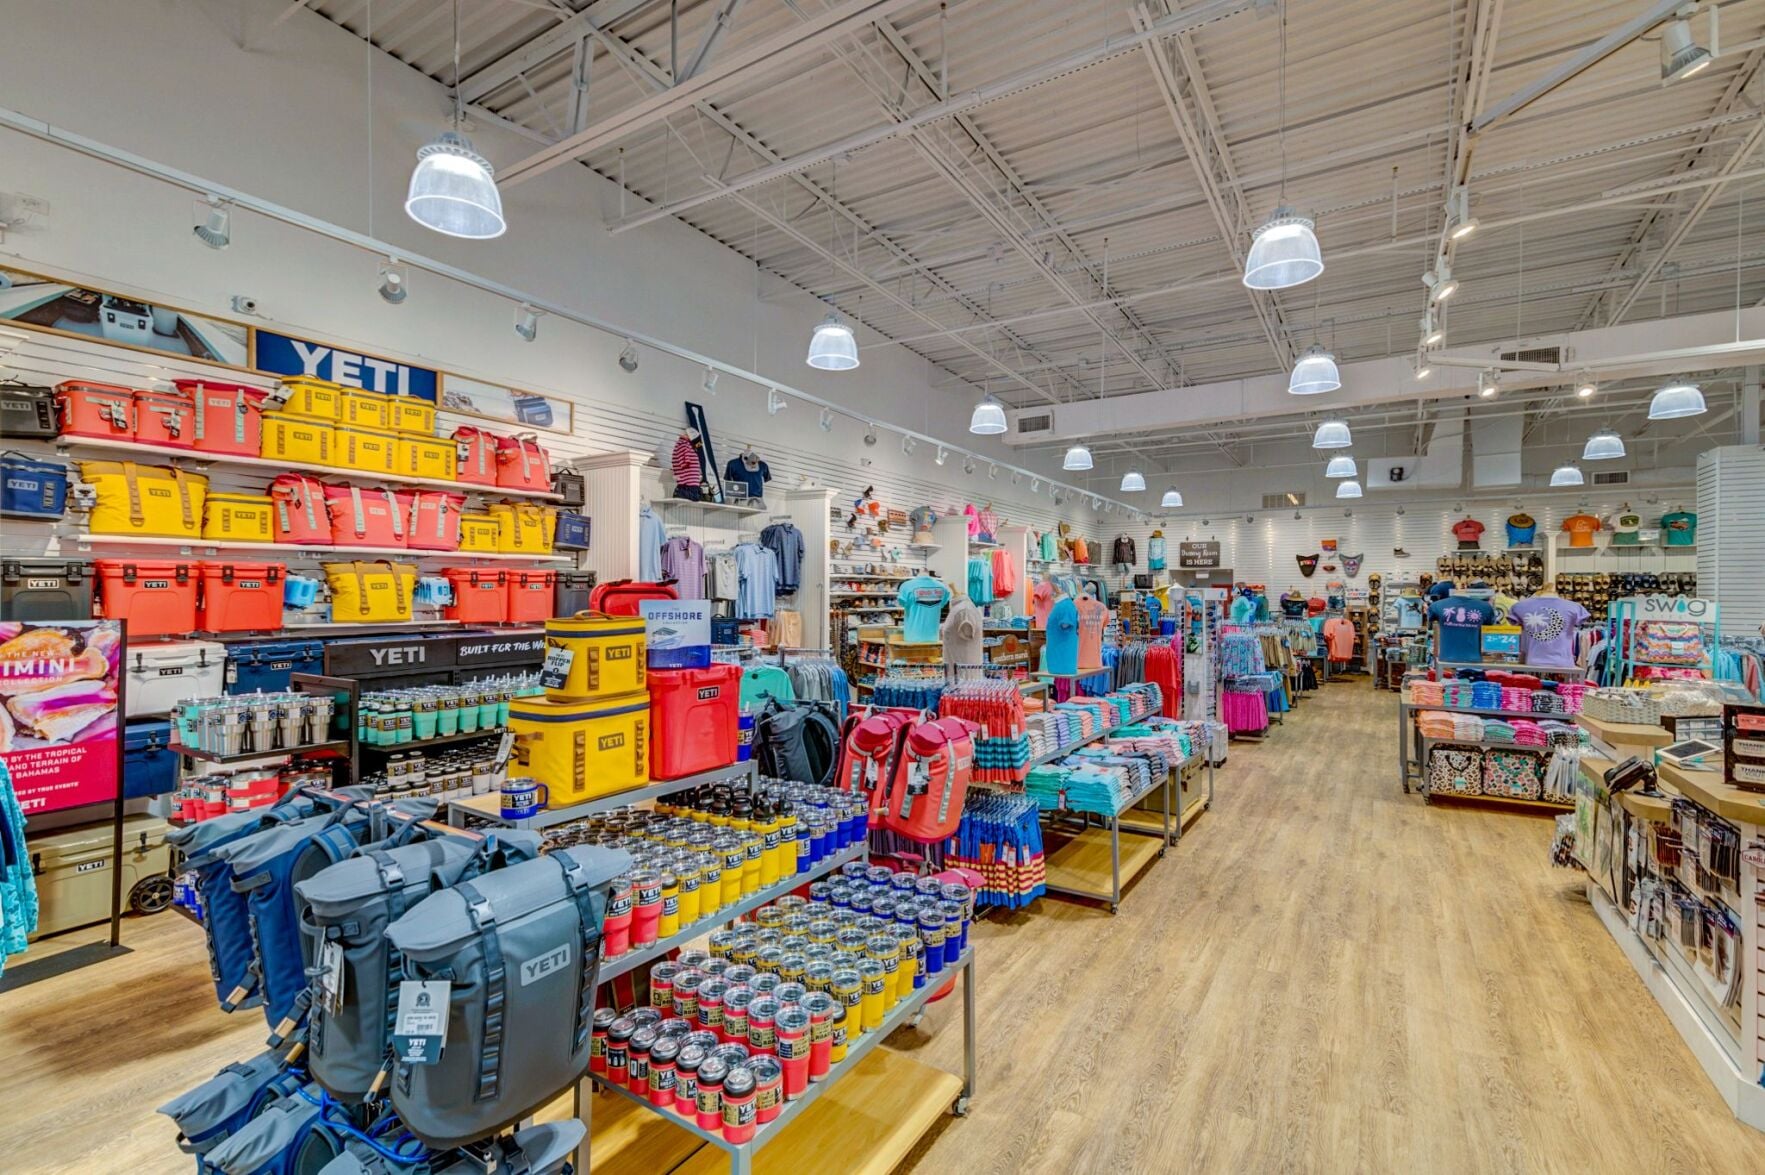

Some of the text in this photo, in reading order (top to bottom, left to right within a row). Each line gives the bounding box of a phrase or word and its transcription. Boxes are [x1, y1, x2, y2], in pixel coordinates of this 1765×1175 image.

[290, 340, 410, 396] YETI
[4, 402, 30, 410] YETI
[10, 480, 37, 489] YETI
[29, 580, 58, 588] YETI
[648, 611, 703, 620] OFFSHORE
[460, 640, 547, 656] BUILT FOR THE WI
[606, 646, 631, 659] YETI
[369, 646, 426, 666] YETI
[3, 658, 75, 677] IMINI
[160, 667, 183, 675] YETI
[272, 662, 291, 670] YETI
[2, 676, 63, 686] OLLECTION
[699, 688, 718, 699] YETI
[600, 734, 623, 749] YETI
[25, 752, 43, 760] THE
[45, 747, 87, 758] TROPICAL
[9, 755, 83, 771] AND TERRAIN OF
[16, 766, 60, 779] BAHAMAS
[514, 792, 532, 801] YETI
[21, 797, 46, 810] ETI
[79, 860, 104, 872] YETI
[641, 885, 662, 898] YETI
[526, 949, 567, 979] YETI
[408, 1038, 427, 1046] YETI
